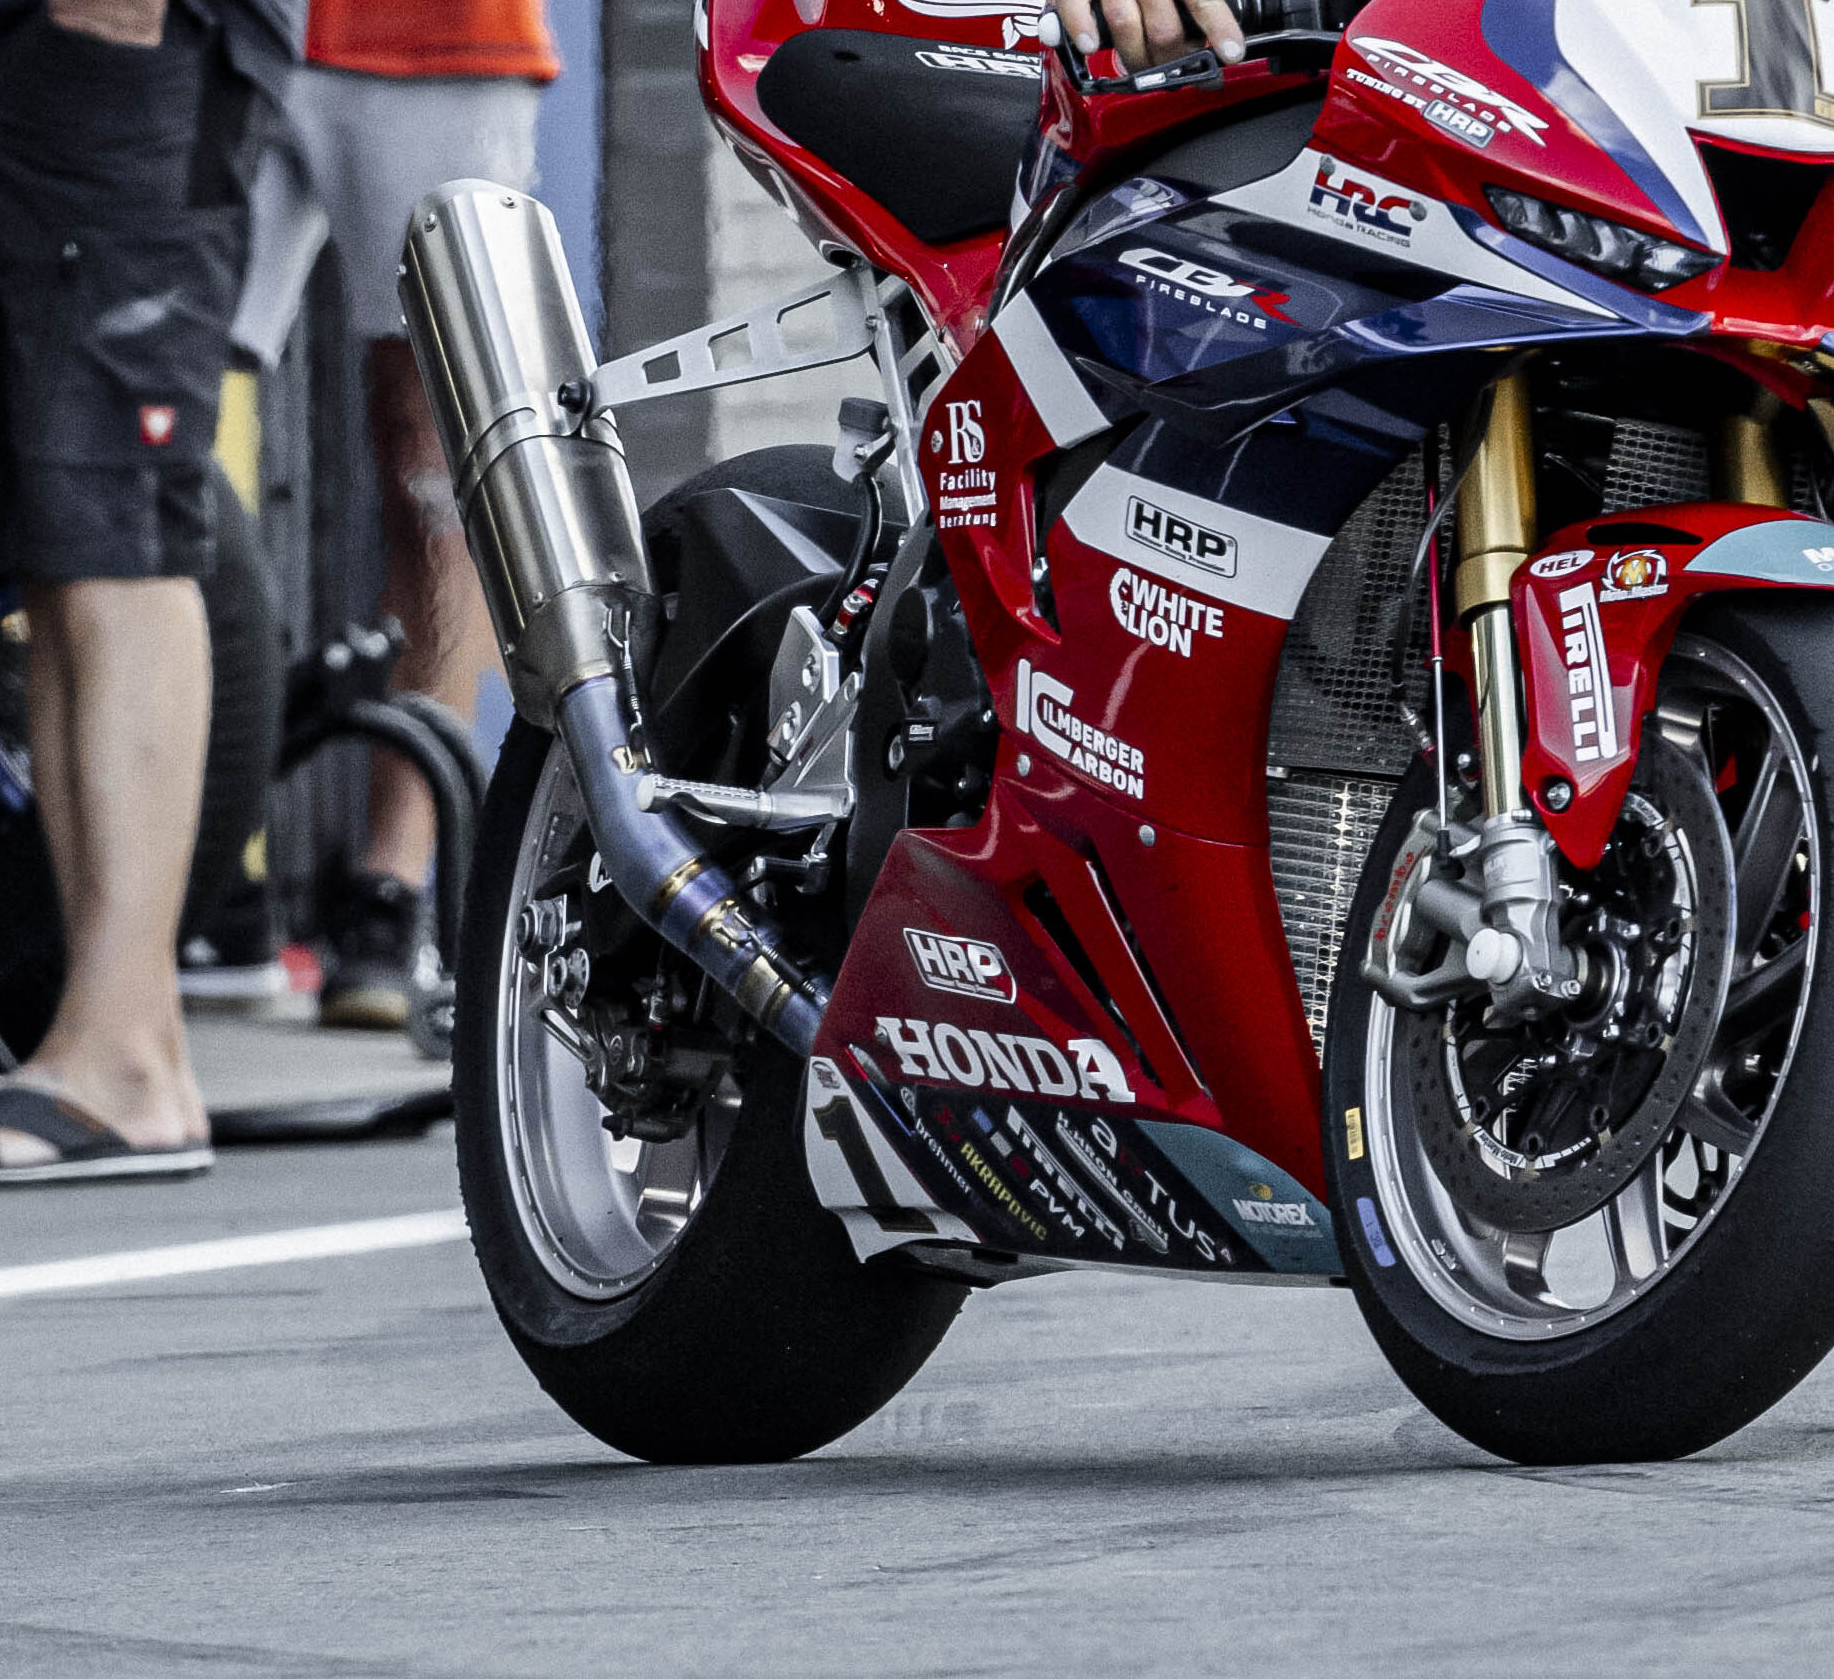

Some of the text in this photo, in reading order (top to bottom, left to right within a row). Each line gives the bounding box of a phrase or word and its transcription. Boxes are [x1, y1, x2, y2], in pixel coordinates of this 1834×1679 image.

[1430, 103, 1488, 140] HRP
[1309, 168, 1413, 237] HRC
[1135, 274, 1267, 330] FIREBLADE
[939, 469, 996, 492] Facility
[939, 512, 997, 529] Beratung
[1134, 501, 1227, 559] HRP
[1538, 555, 1583, 575] HEL
[1126, 606, 1192, 659] LION
[1131, 573, 1224, 639] WHITE
[1559, 581, 1619, 763] PIRELLI
[910, 933, 1003, 985] HRP
[875, 1016, 1136, 1103] HONDA
[812, 1094, 939, 1234] 1
[1030, 1178, 1086, 1238] PVM
[1232, 1198, 1316, 1226] MOTOREX
